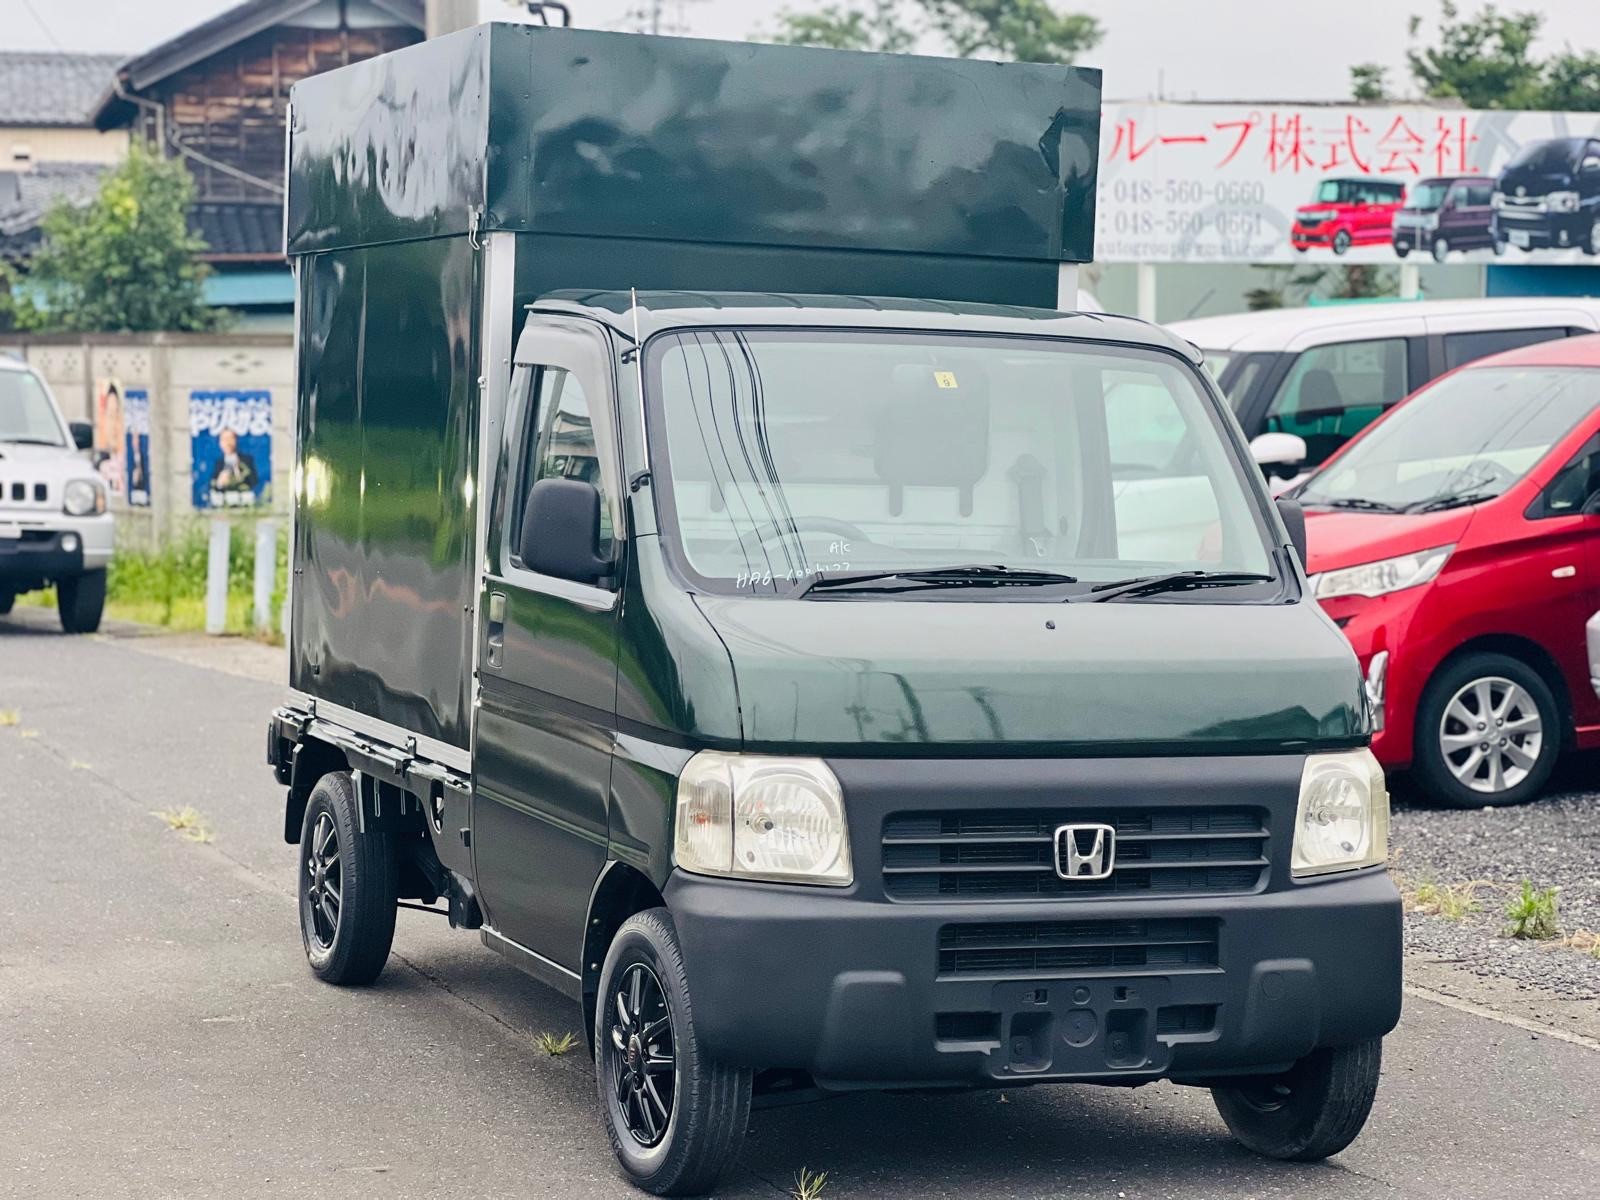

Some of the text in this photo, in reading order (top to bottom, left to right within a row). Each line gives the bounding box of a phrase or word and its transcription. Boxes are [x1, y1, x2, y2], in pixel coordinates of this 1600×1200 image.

[1099, 112, 1481, 176] ループ株式会社
